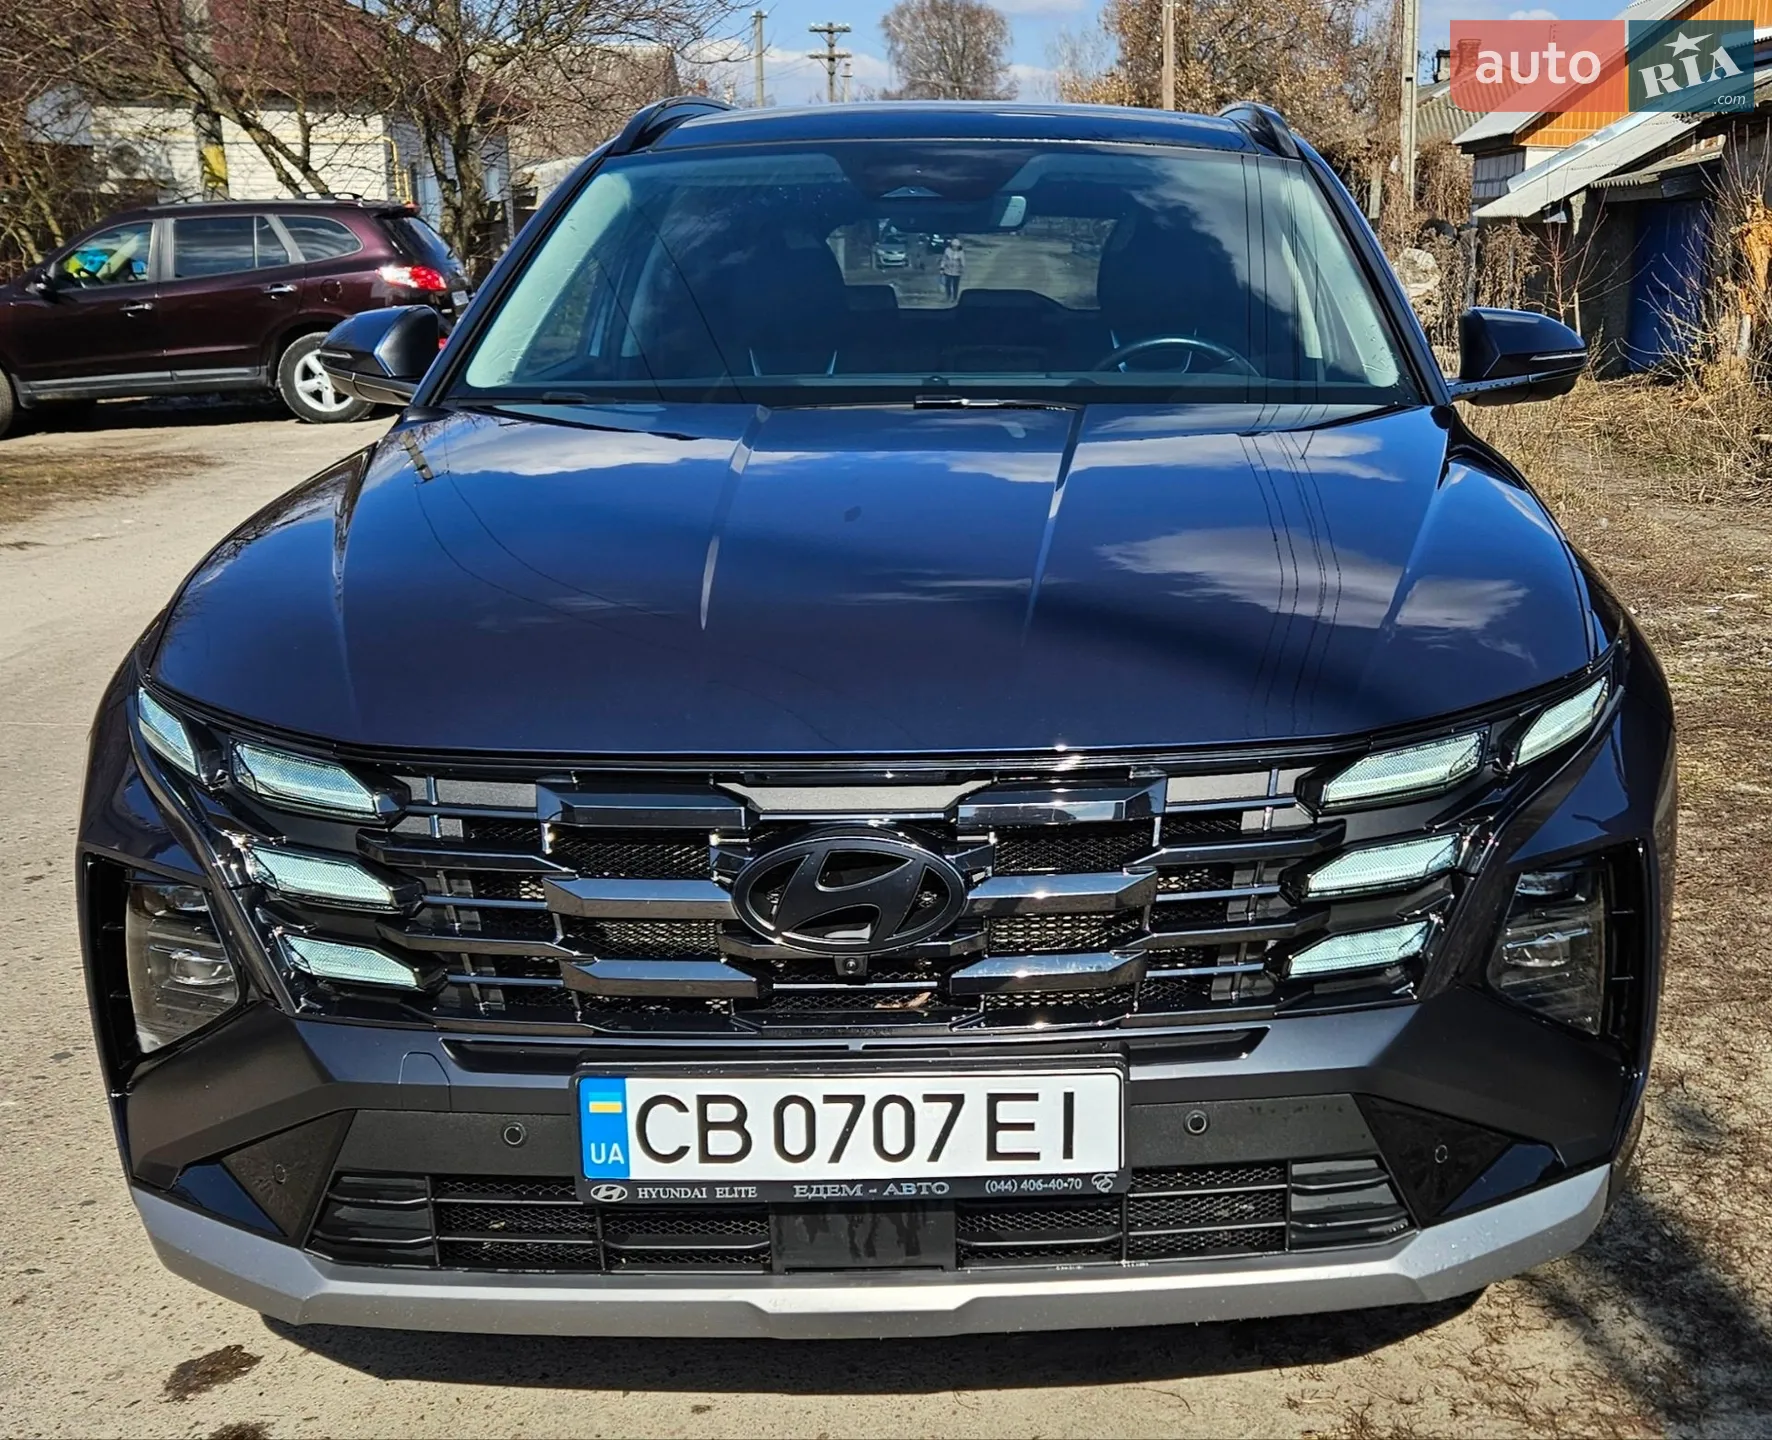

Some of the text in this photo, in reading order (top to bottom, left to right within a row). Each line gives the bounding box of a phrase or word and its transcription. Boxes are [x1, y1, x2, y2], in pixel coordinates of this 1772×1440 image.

[635, 1091, 1075, 1164] CB 0707 EI
[590, 1142, 625, 1165] UA
[637, 1186, 758, 1199] HYUNDAI ELITE
[793, 1183, 863, 1199] ЕДЕМ
[882, 1181, 950, 1196] АВТО
[985, 1177, 1083, 1194] (044) 406-40-70
